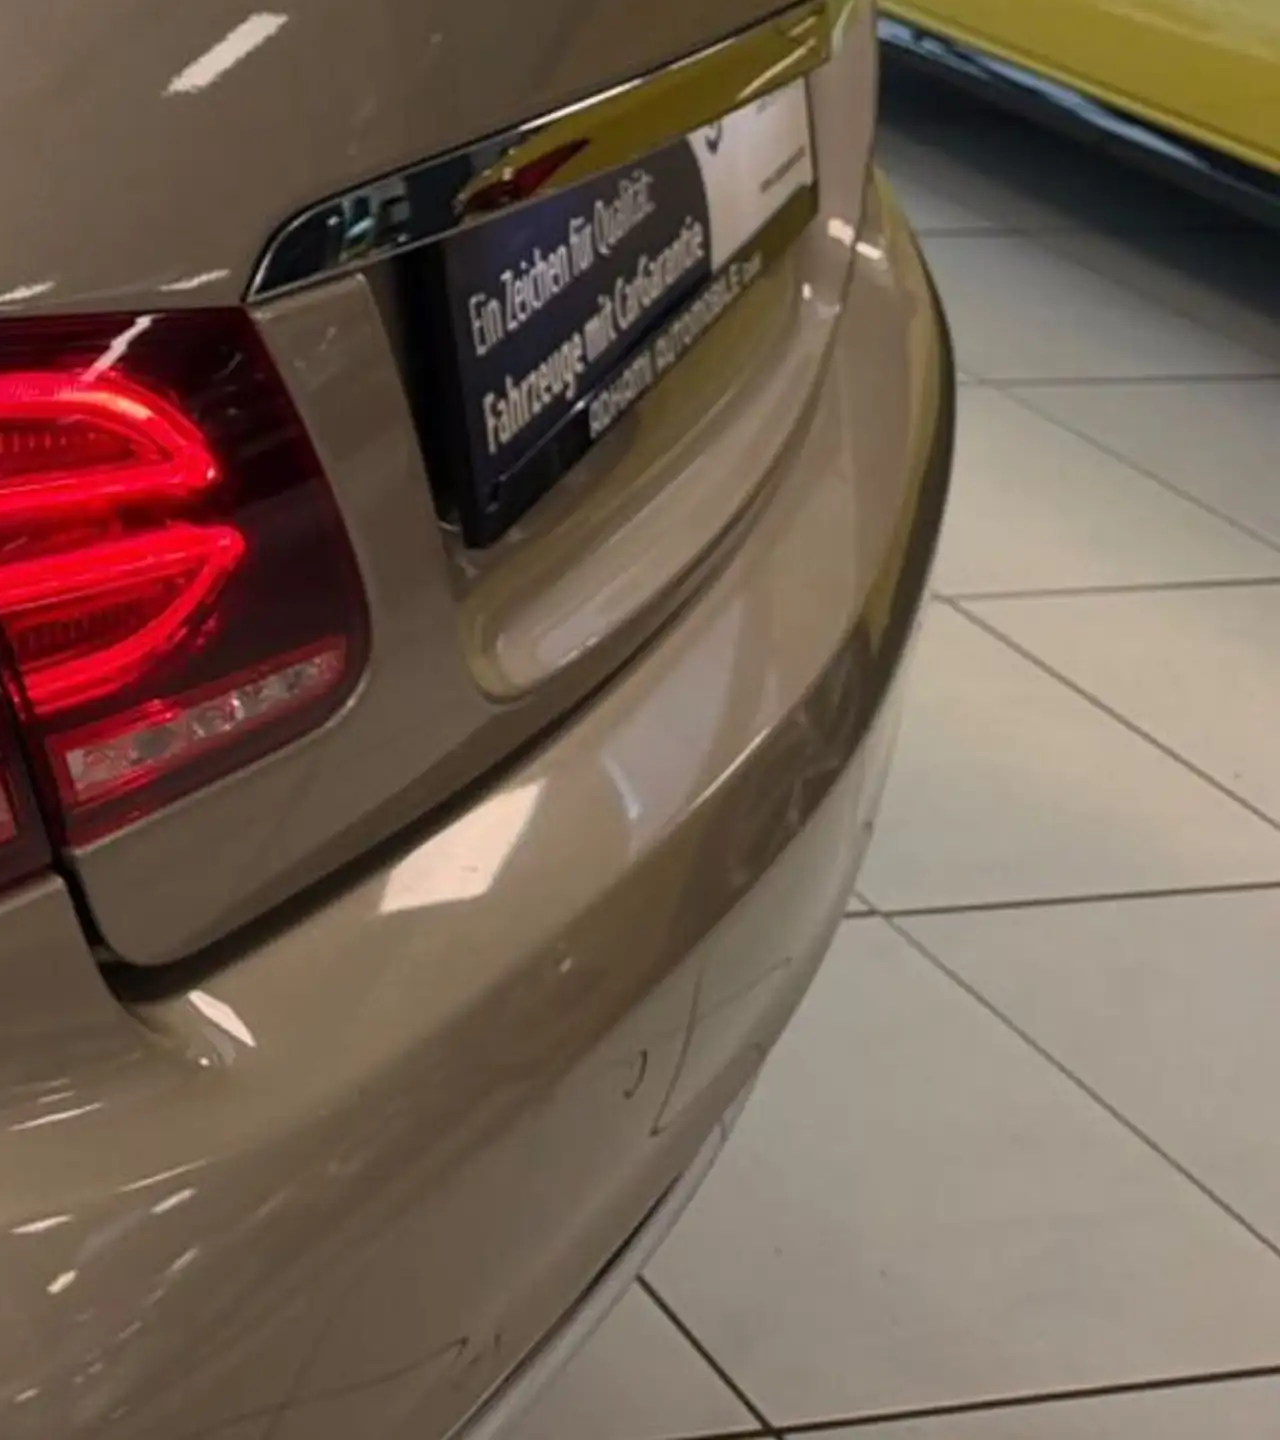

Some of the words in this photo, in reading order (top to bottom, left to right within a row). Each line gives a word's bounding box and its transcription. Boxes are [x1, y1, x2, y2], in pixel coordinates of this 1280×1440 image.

[468, 291, 505, 357] Ein
[500, 246, 572, 332] Zeichen
[569, 215, 594, 278] für
[482, 331, 586, 456] Fahrzeuge
[583, 293, 617, 364] mit
